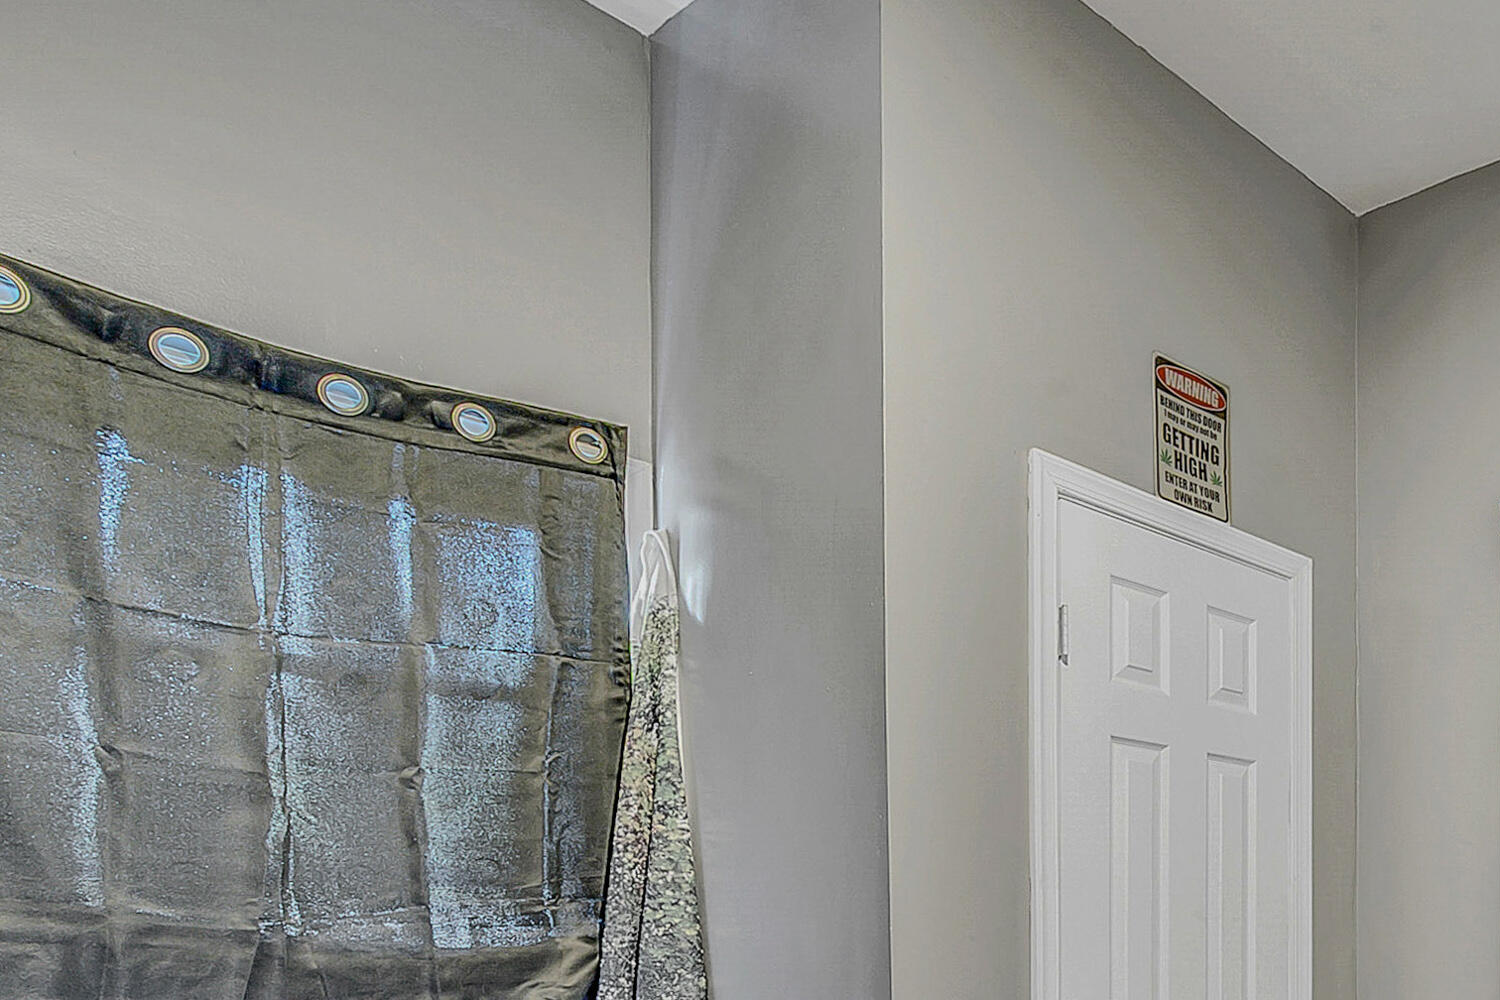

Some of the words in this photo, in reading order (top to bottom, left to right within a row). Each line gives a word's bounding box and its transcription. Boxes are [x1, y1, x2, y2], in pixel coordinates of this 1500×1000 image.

[1165, 368, 1219, 408] WARNING
[1160, 395, 1185, 415] BEHIND
[1186, 407, 1202, 424] THIS
[1203, 416, 1222, 433] DOOR
[1168, 412, 1179, 424] may
[1187, 422, 1199, 434] may
[1163, 423, 1219, 466] GETTING
[1174, 450, 1208, 482] HIGH
[1165, 471, 1188, 491] ENTER
[1189, 482, 1198, 494] AT
[1199, 485, 1220, 503] YOUR
[1174, 489, 1193, 506] OWN
[1194, 497, 1213, 513] RISK
